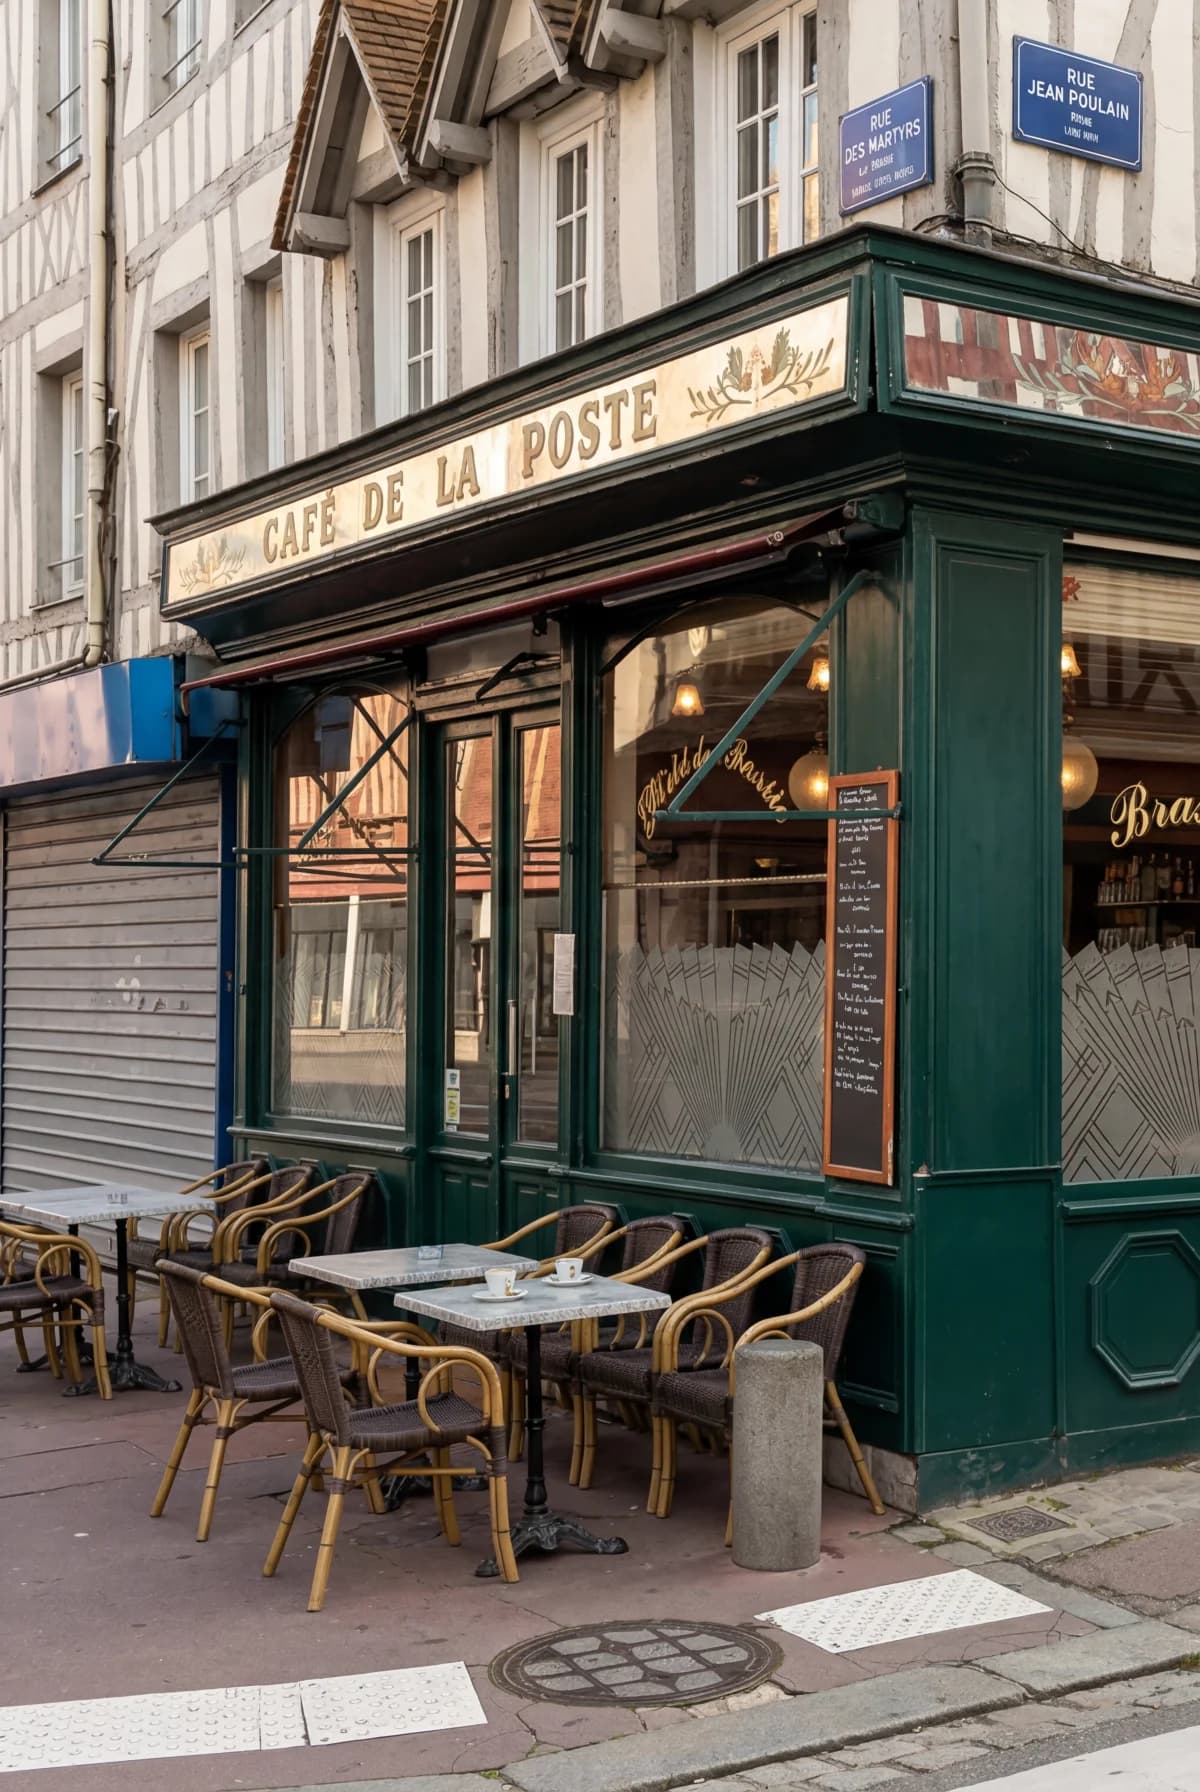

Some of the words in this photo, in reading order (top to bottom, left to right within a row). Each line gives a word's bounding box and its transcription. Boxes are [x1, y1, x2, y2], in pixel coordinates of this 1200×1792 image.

[1027, 79, 1064, 103] JEAN
[1069, 89, 1130, 121] POULAIN
[1067, 67, 1096, 91] RUE
[870, 108, 892, 132] RUE
[845, 142, 866, 165] DES
[868, 118, 921, 155] MARTYRS
[262, 488, 337, 565] CAFÉ
[363, 470, 404, 531] DE
[436, 444, 480, 508] LA
[521, 378, 658, 480] POSTE
